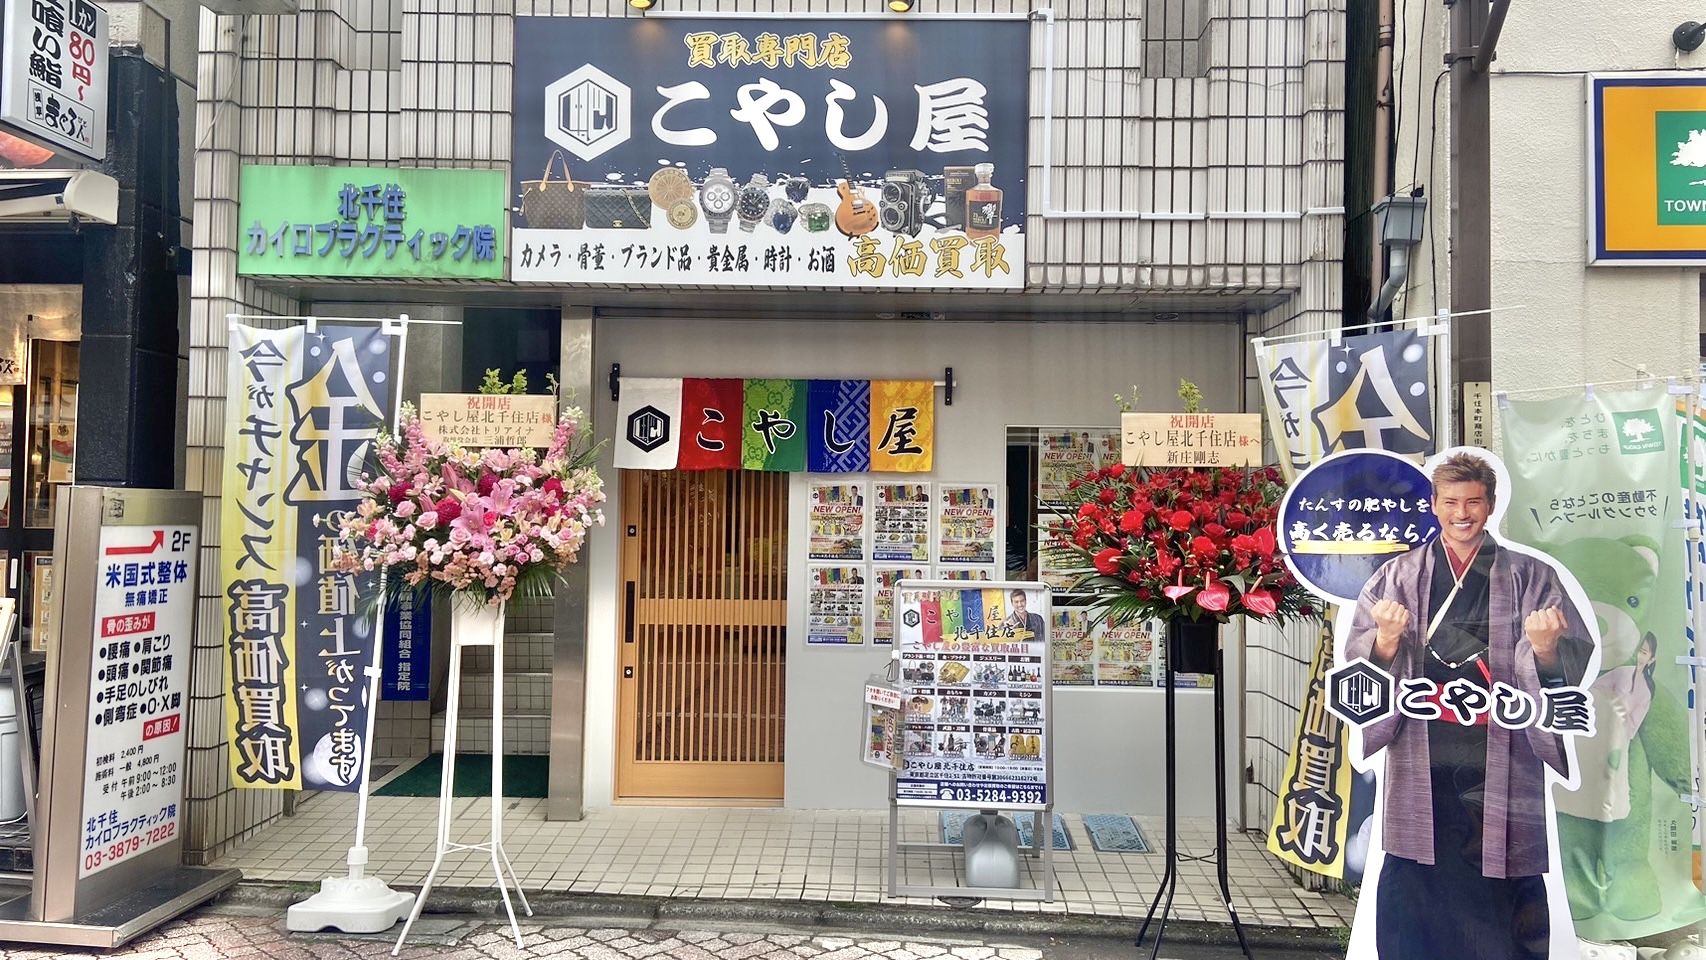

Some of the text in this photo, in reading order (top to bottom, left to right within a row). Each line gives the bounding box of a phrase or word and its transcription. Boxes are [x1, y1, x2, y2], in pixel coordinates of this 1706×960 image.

[29, 0, 65, 90] 喰い鮨
[685, 32, 853, 69] 買取専門店
[651, 77, 990, 153] こやし屋
[338, 183, 407, 221] 北千住
[247, 220, 497, 262] カイロプラクティック院
[846, 234, 1010, 279] 高価買取
[467, 396, 512, 410] 祝開店
[422, 410, 553, 424] こやし屋北千住店様
[1170, 415, 1215, 428] 祝開店
[438, 425, 535, 435] 株式会社トリアイナ
[696, 406, 923, 457] こやし屋
[1126, 430, 1260, 448] こやし屋北千住店様へ
[1044, 452, 1065, 460] NEW
[1167, 450, 1220, 464] 新庄剛志
[813, 505, 834, 513] NEW
[1299, 497, 1430, 513] たんすの肥やしを
[171, 530, 191, 552] 2F
[1289, 521, 1436, 543] 高く売るなら!
[105, 560, 188, 588] 米国式整体
[125, 588, 168, 607] 無痛矯正
[107, 615, 150, 634] 骨の歪みが
[927, 605, 1002, 624] こやし屋
[953, 623, 1016, 641] 北千住店
[1101, 631, 1150, 640] NEW OPEN!
[107, 634, 171, 661] 腰痛 肩こり
[106, 654, 173, 682] 頭痛 関節痛
[397, 662, 411, 691] 指定院
[104, 675, 169, 704] 手足のしびれ
[1400, 680, 1592, 734] こやし屋
[910, 760, 975, 772] こやし屋北千住店
[956, 788, 1042, 804] 03-5284-9392
[86, 809, 119, 833] 北千住
[85, 821, 175, 871] 03-3879-7222
